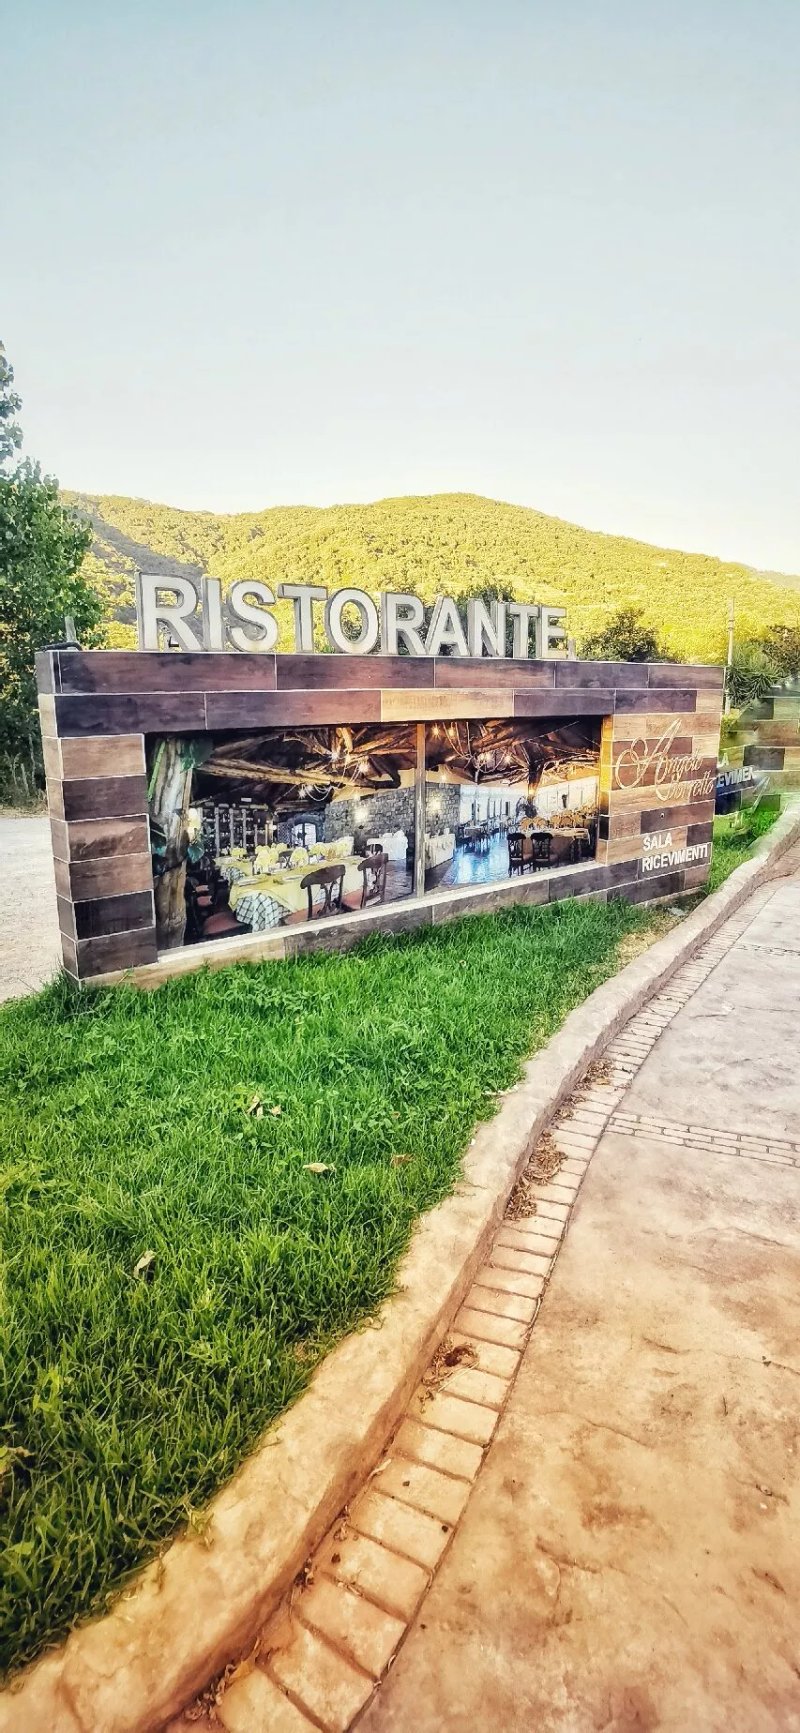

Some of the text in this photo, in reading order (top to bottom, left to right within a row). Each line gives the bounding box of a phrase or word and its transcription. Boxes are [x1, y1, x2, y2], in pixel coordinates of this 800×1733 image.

[136, 572, 567, 659] RISTORANTE
[643, 832, 672, 851] SALA
[642, 844, 708, 872] RICEVIMENTI
